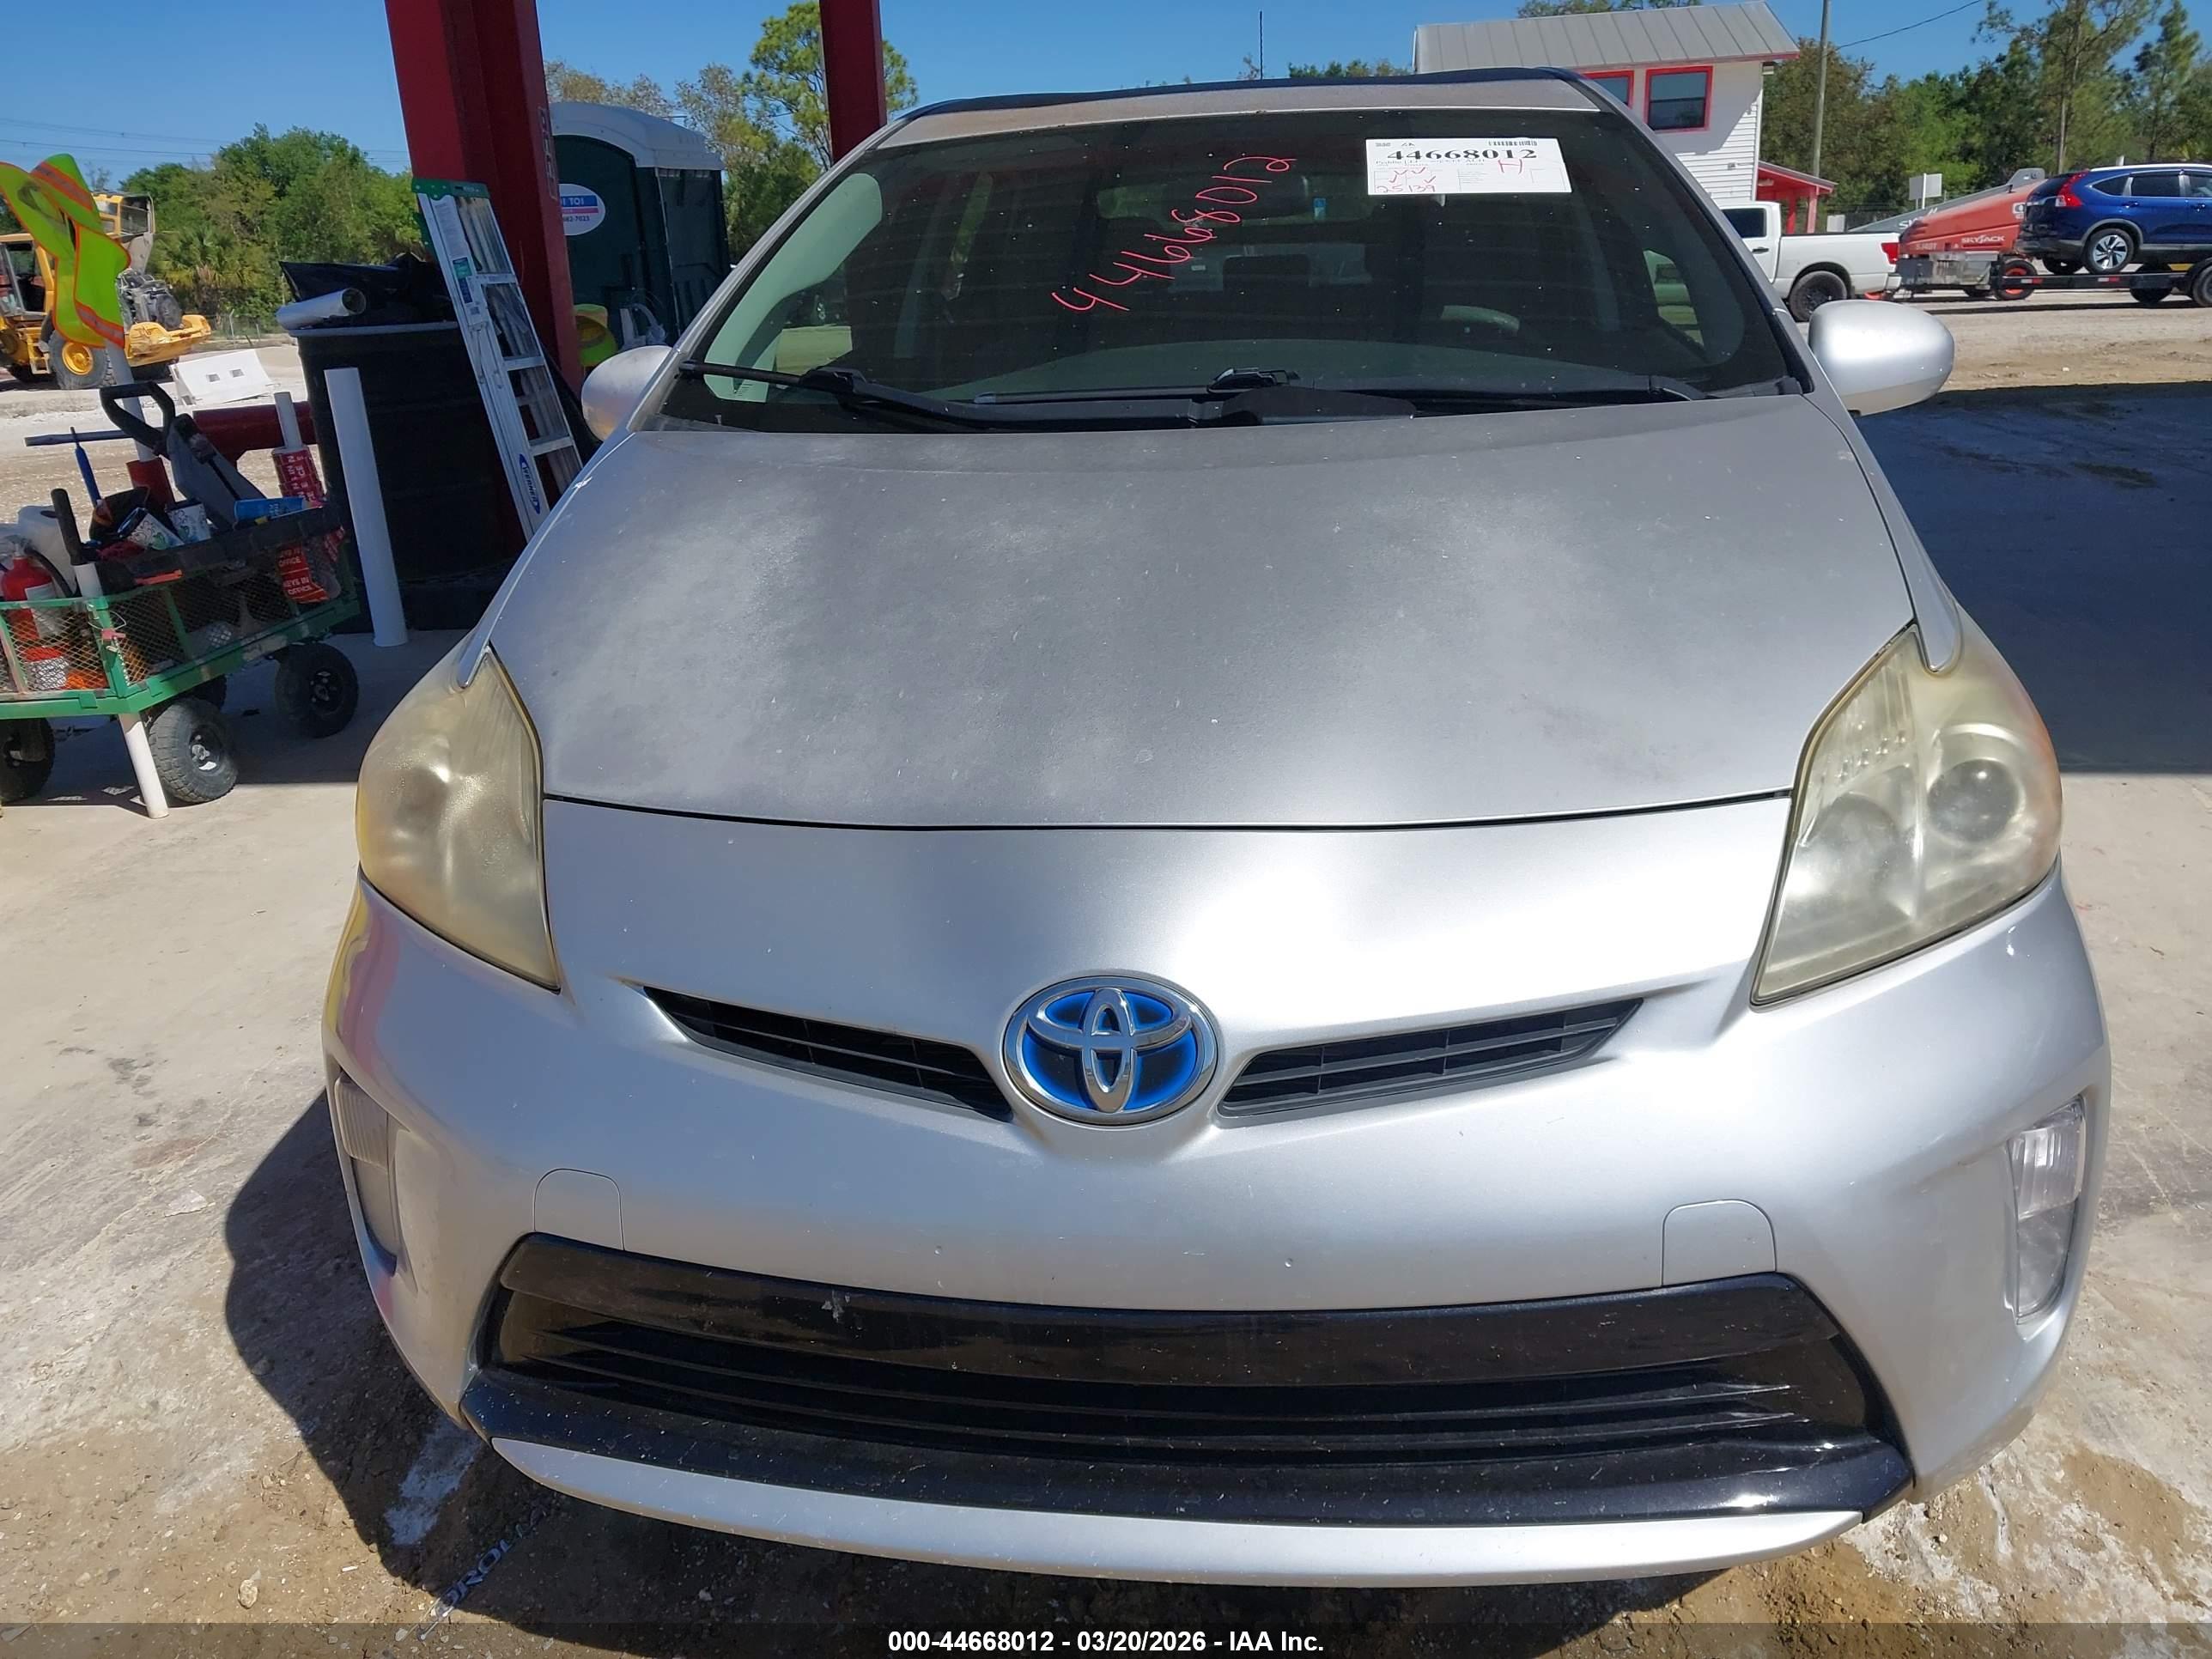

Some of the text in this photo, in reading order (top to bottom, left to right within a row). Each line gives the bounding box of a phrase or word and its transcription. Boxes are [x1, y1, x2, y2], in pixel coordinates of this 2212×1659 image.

[1387, 149, 1537, 160] 44668012
[1052, 155, 1297, 312] 44668012
[1961, 234, 2006, 244] SKYJACK
[278, 556, 302, 567] OFFICE
